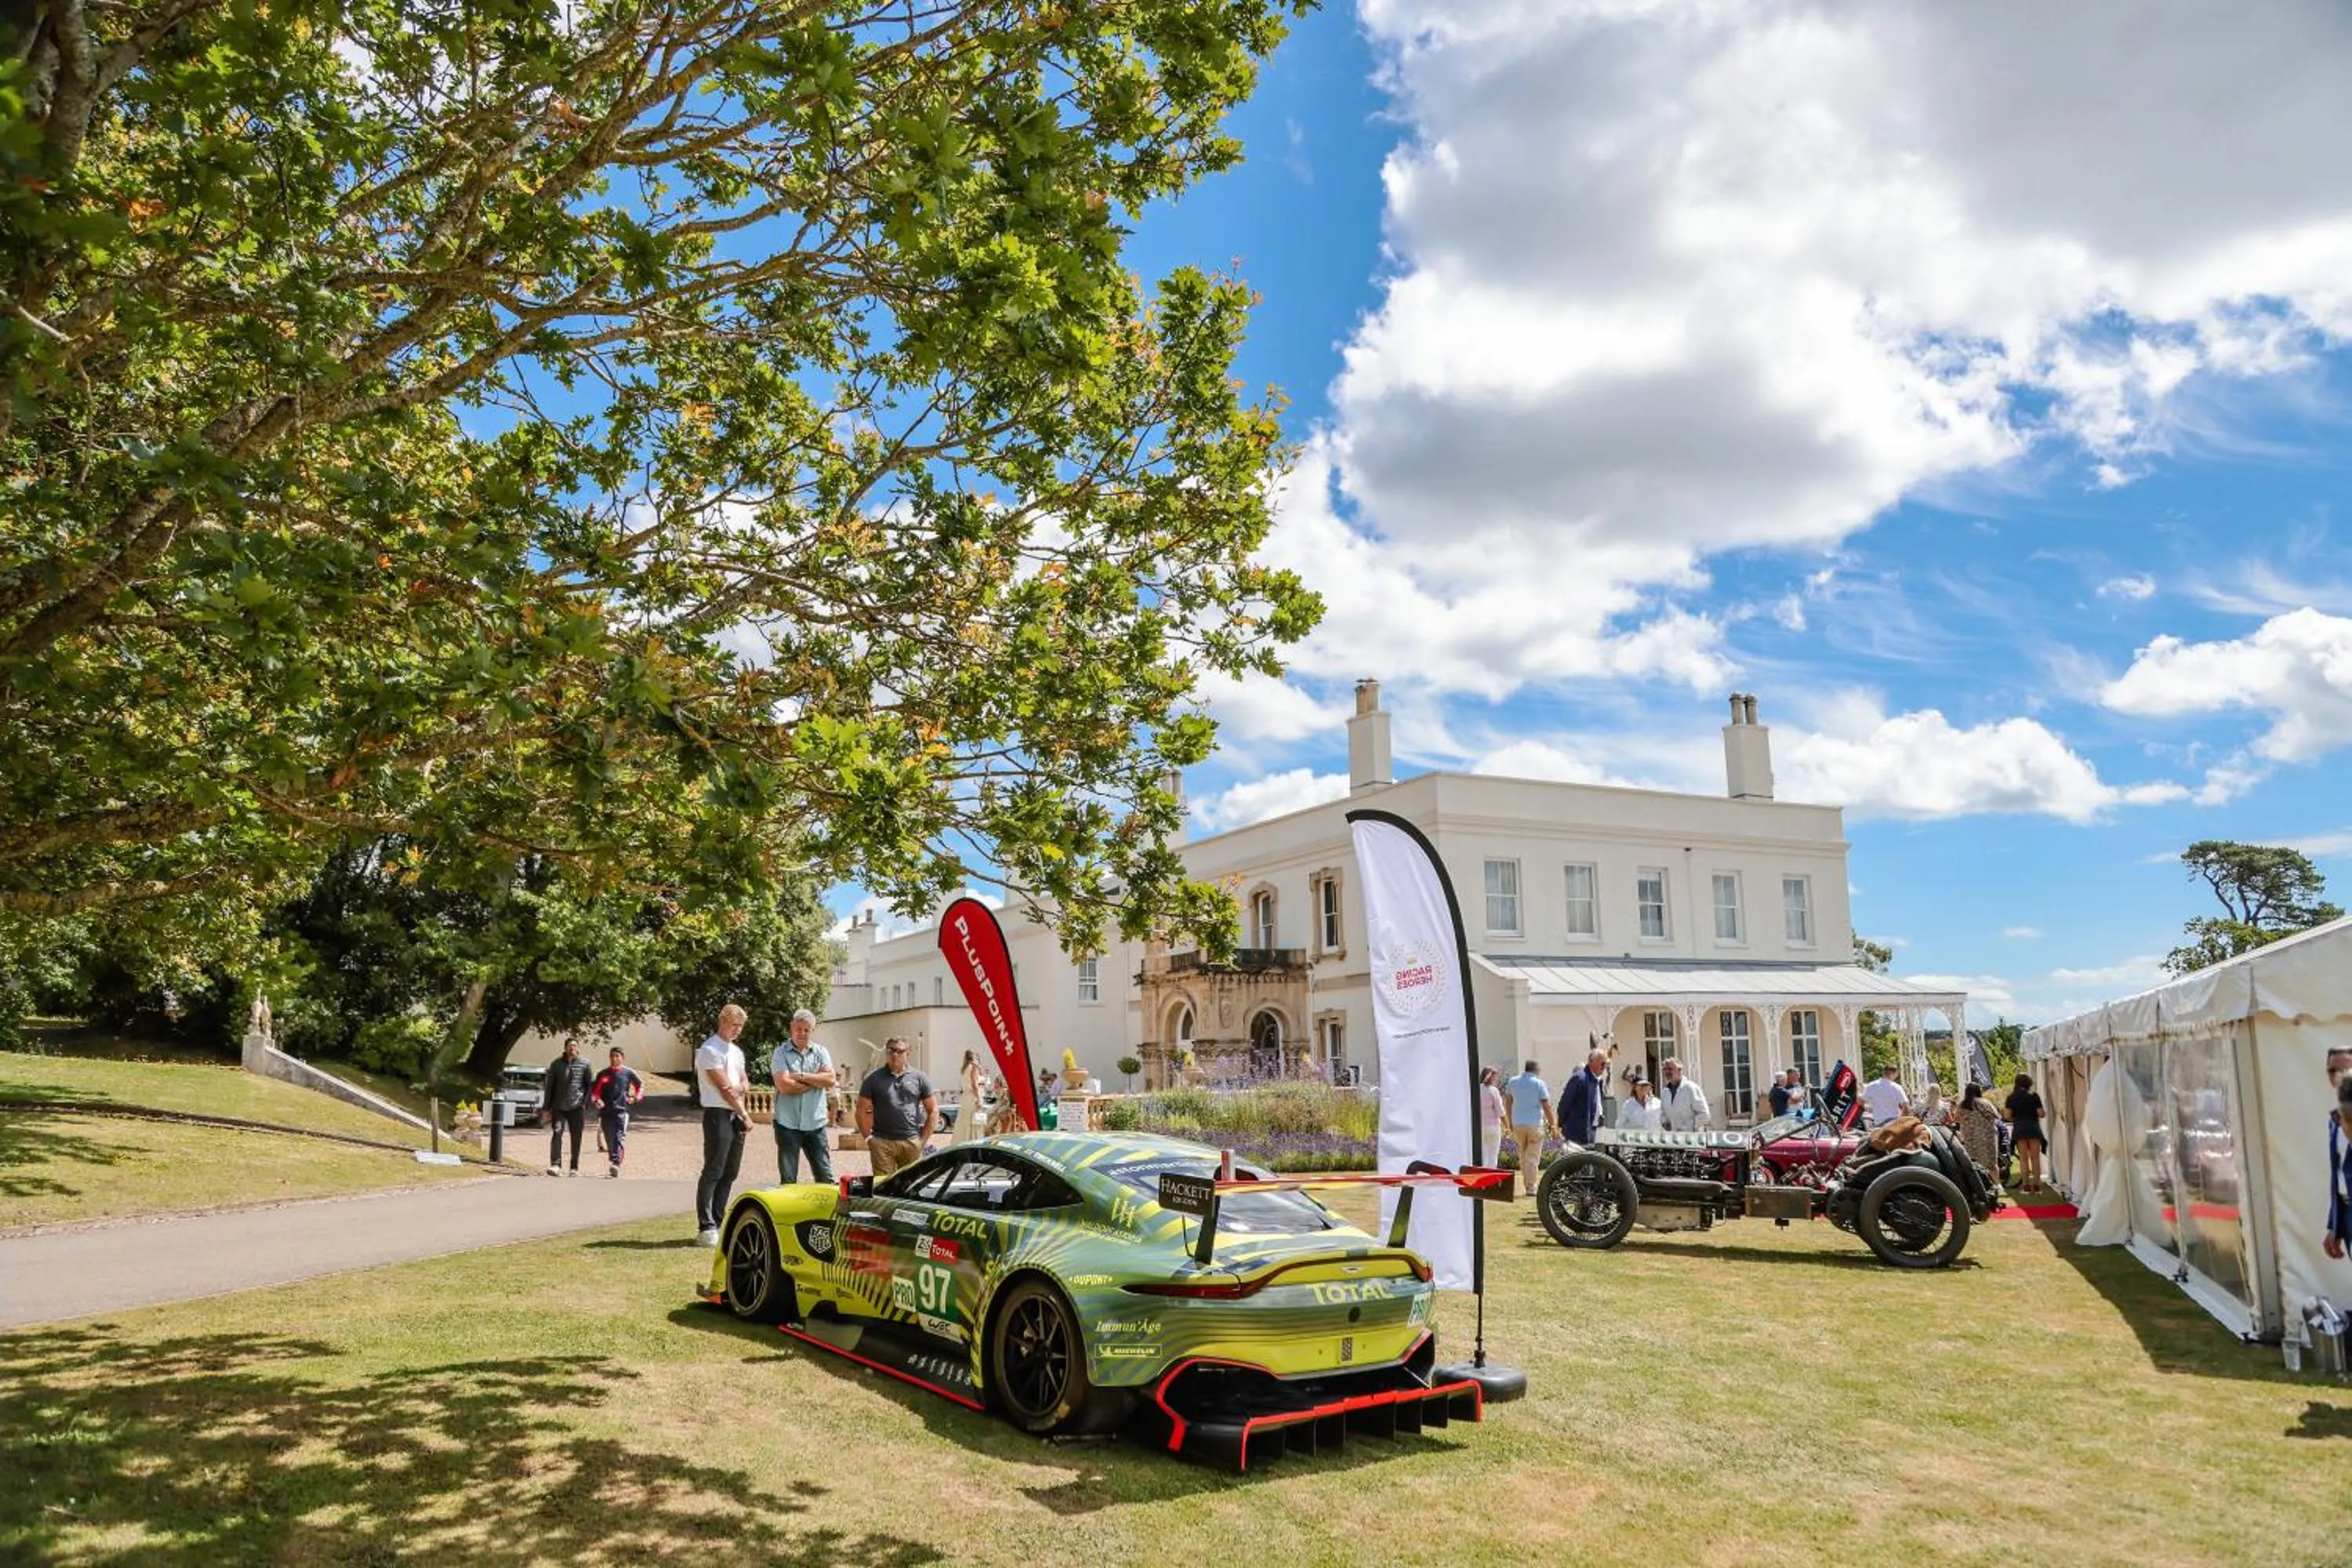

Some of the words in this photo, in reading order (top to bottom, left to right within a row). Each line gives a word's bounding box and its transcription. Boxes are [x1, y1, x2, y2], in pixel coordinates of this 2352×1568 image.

[1161, 1178, 1211, 1200] HACKETT
[932, 1210, 987, 1239] TOTAL
[931, 1244, 955, 1258] TOTAL
[919, 1264, 951, 1314] 97
[1305, 1282, 1397, 1305] TOTAL
